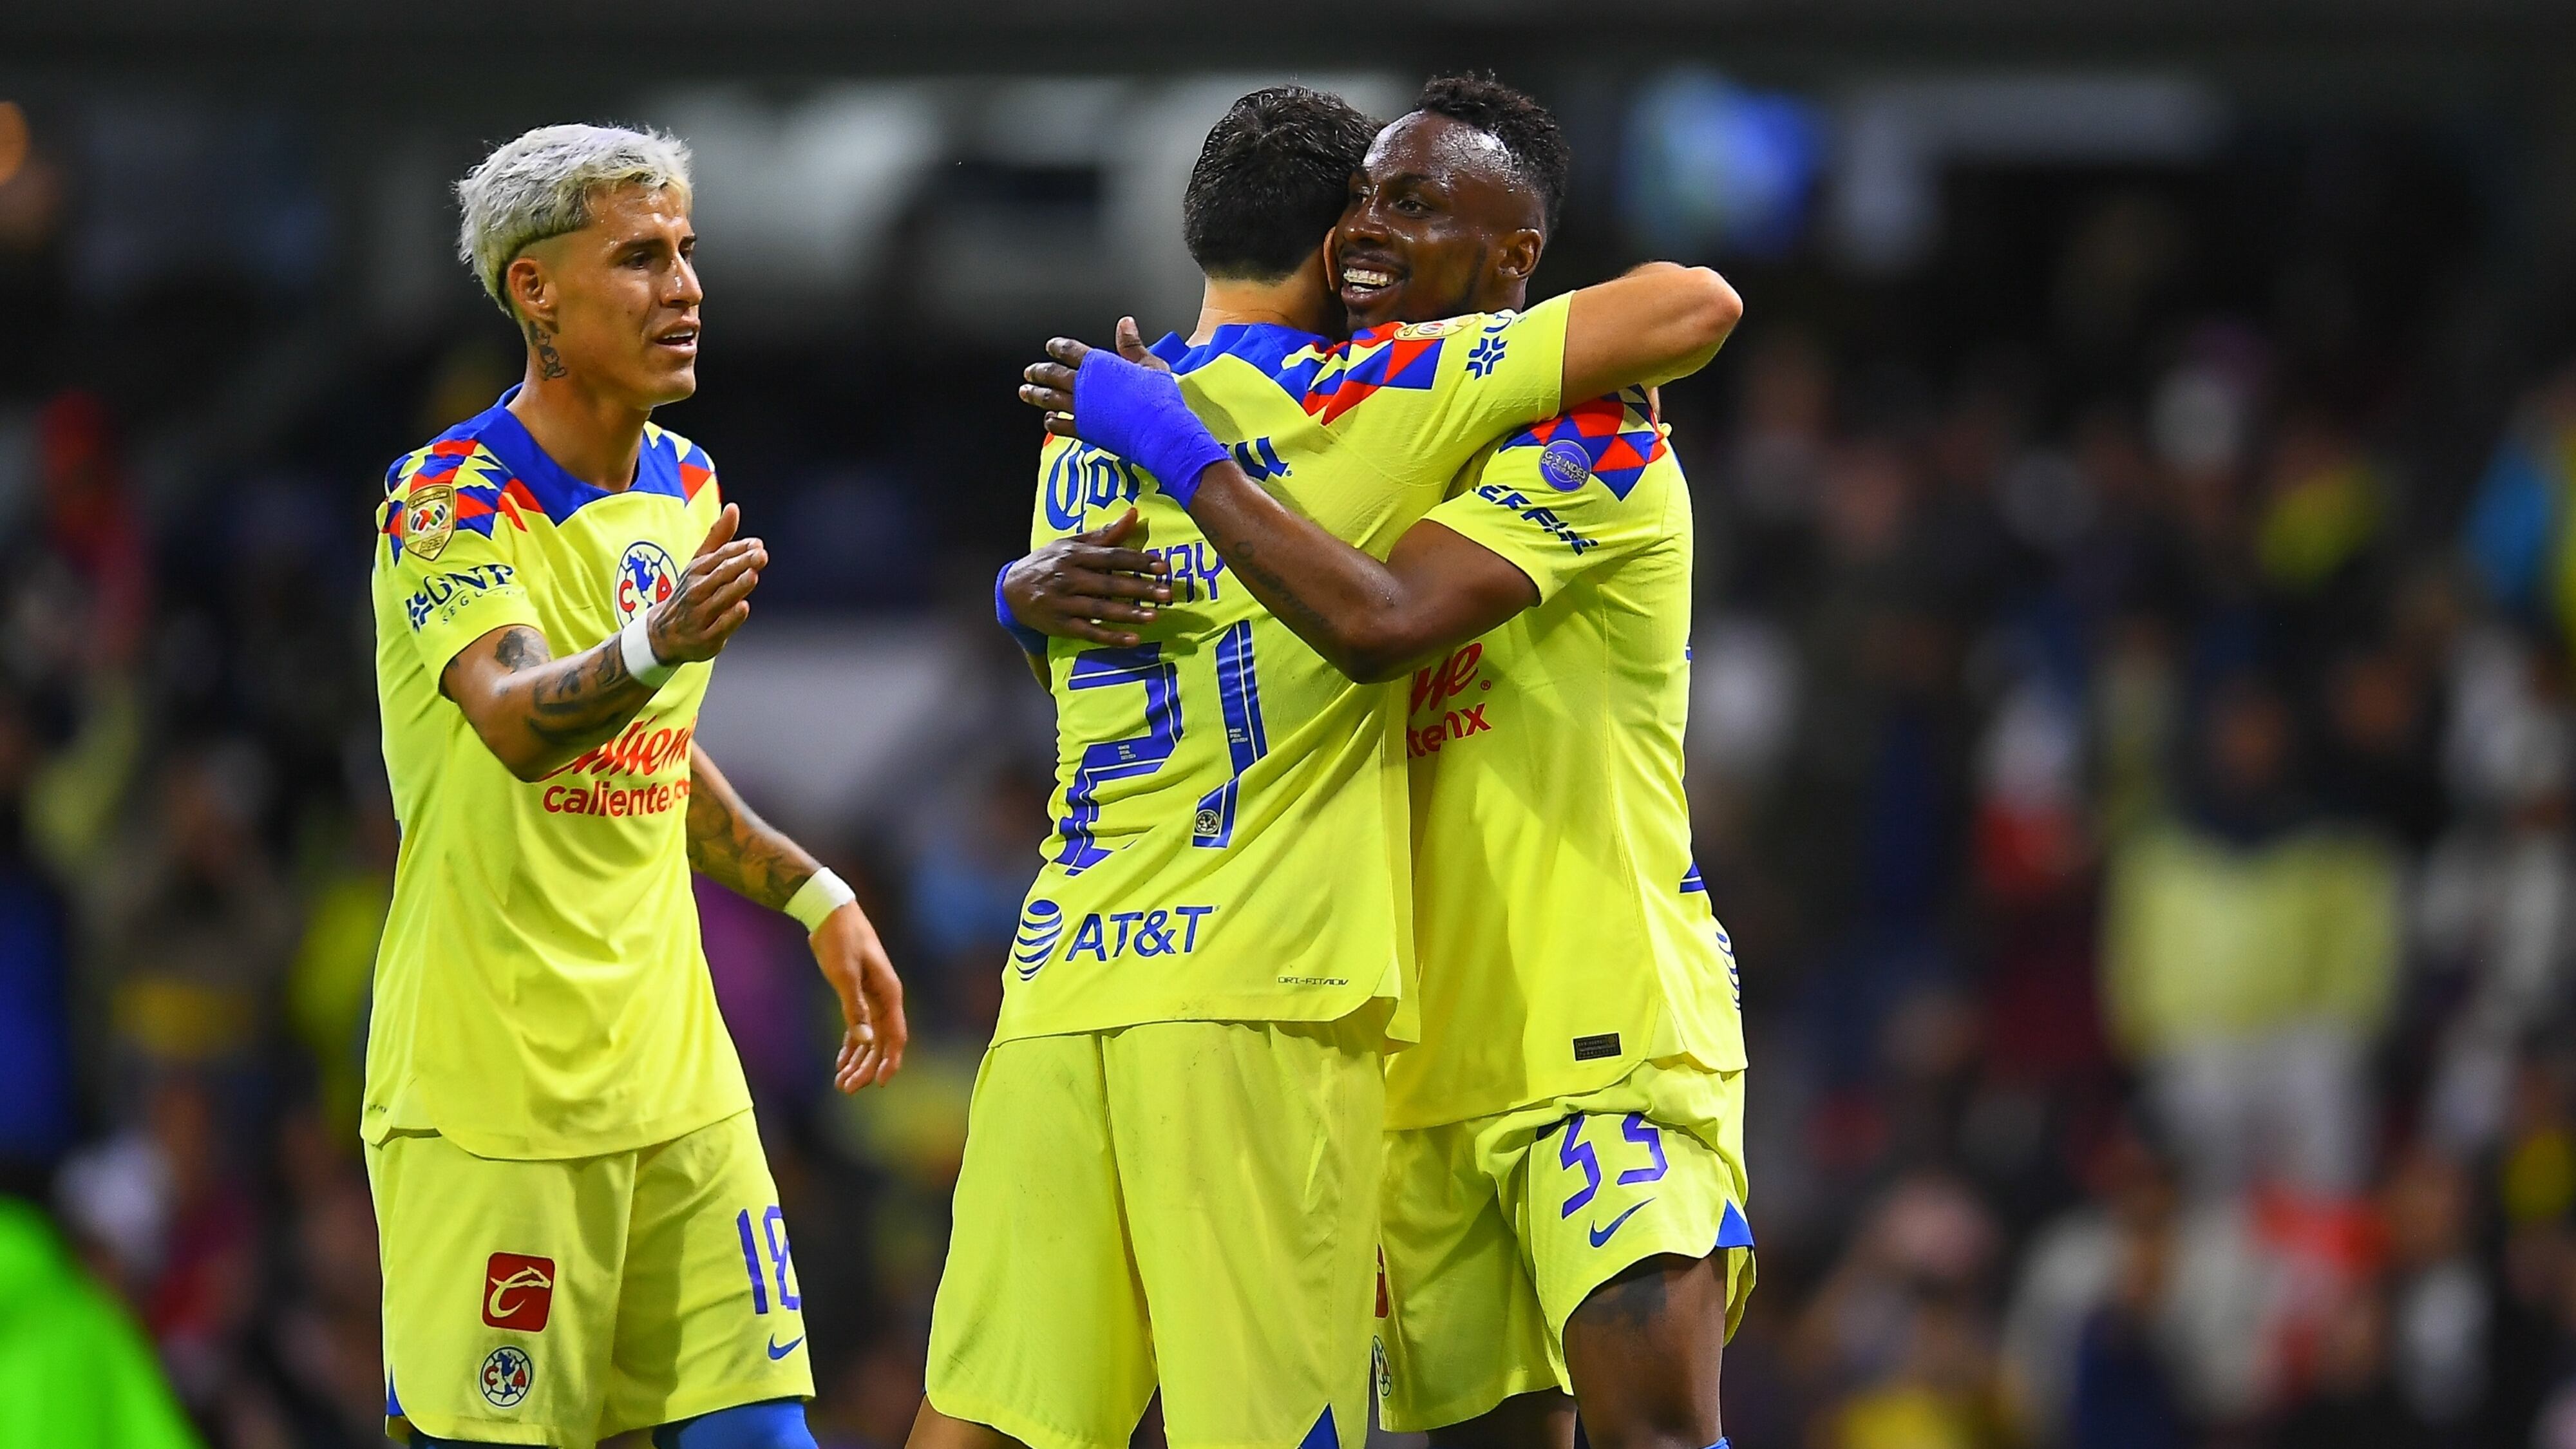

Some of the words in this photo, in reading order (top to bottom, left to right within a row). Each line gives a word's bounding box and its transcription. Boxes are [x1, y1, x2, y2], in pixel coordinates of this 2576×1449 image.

[1544, 451, 1588, 480] GRNDES
[423, 564, 514, 605] GNP
[1050, 620, 1268, 877] 21
[1065, 905, 1214, 961] AT&T
[736, 1205, 801, 1314] 18
